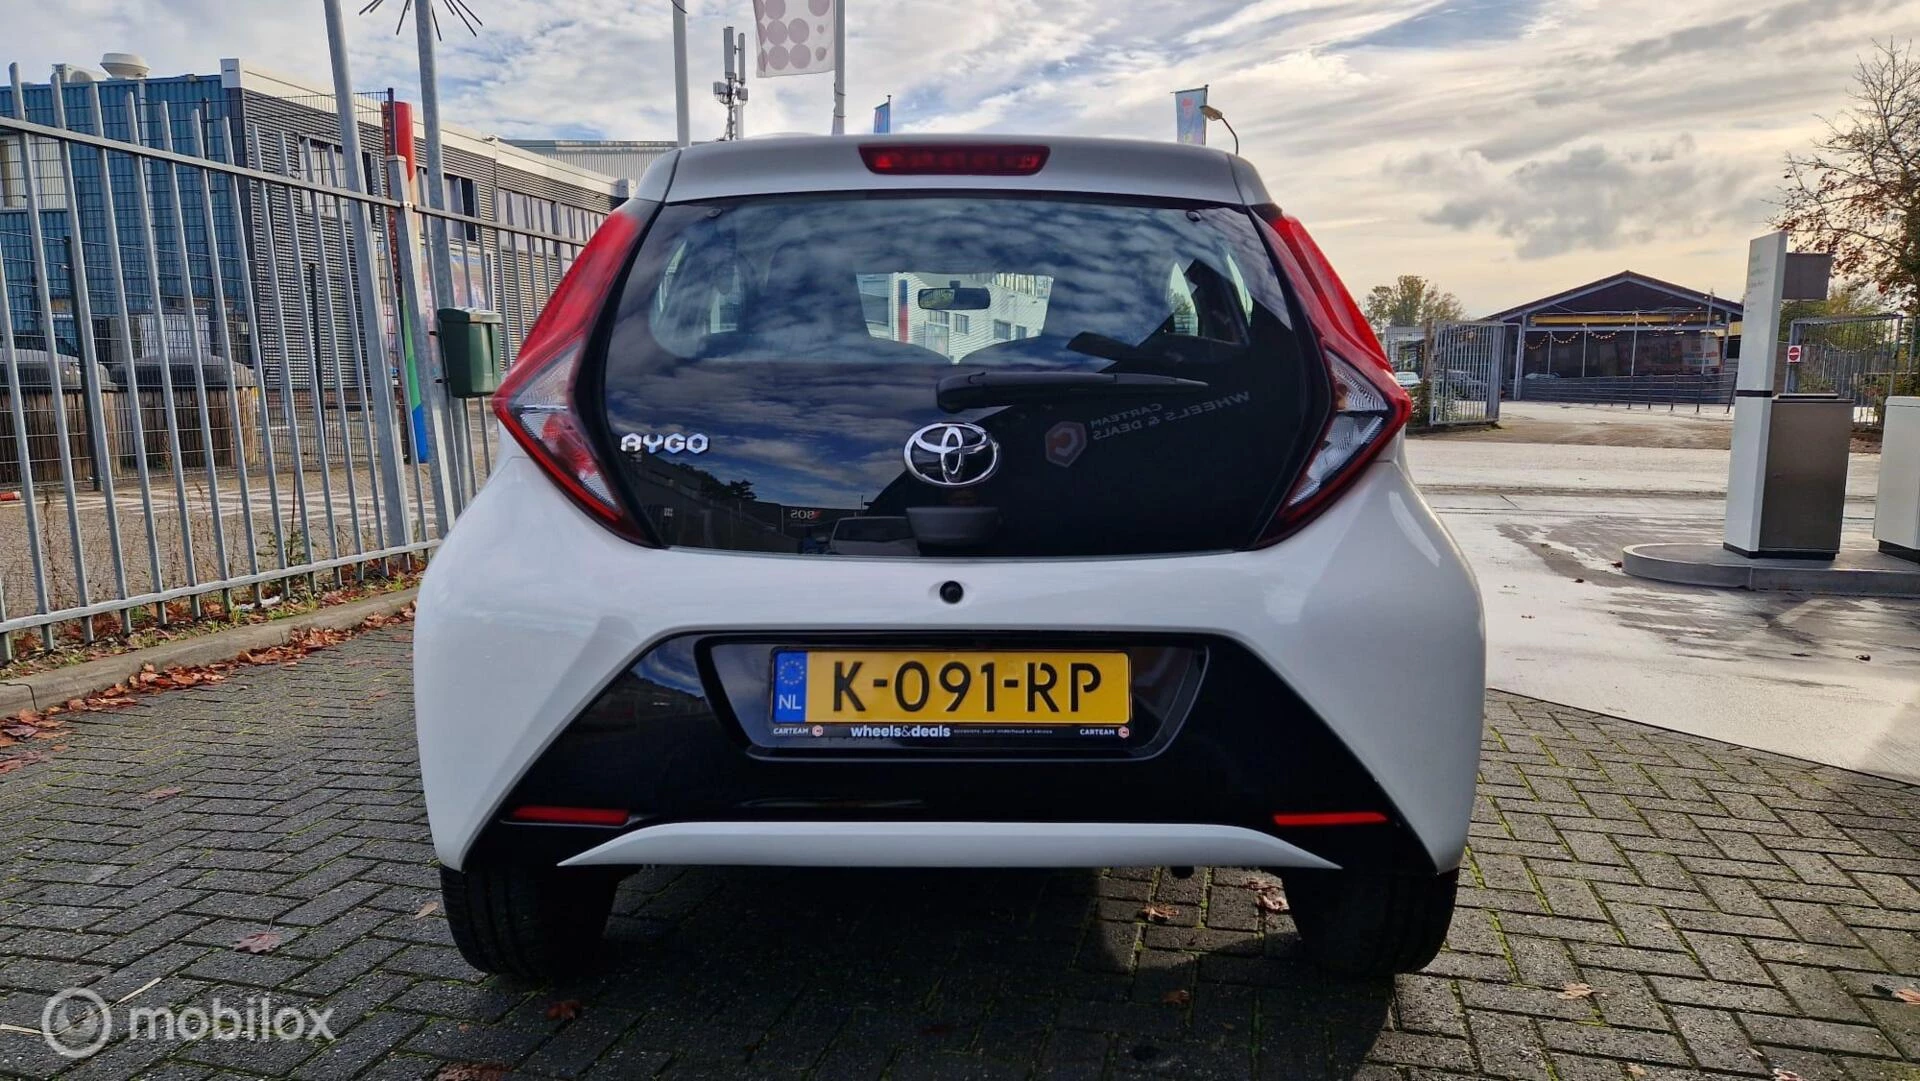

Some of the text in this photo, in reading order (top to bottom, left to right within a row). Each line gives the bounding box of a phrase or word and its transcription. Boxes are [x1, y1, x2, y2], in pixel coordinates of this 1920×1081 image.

[621, 432, 709, 454] AYGO
[832, 661, 1102, 713] K-091-RP
[778, 694, 802, 710] NL
[773, 727, 809, 735] CARTEAM
[850, 725, 951, 737] wheels&deals
[1079, 728, 1115, 736] CARTEAM
